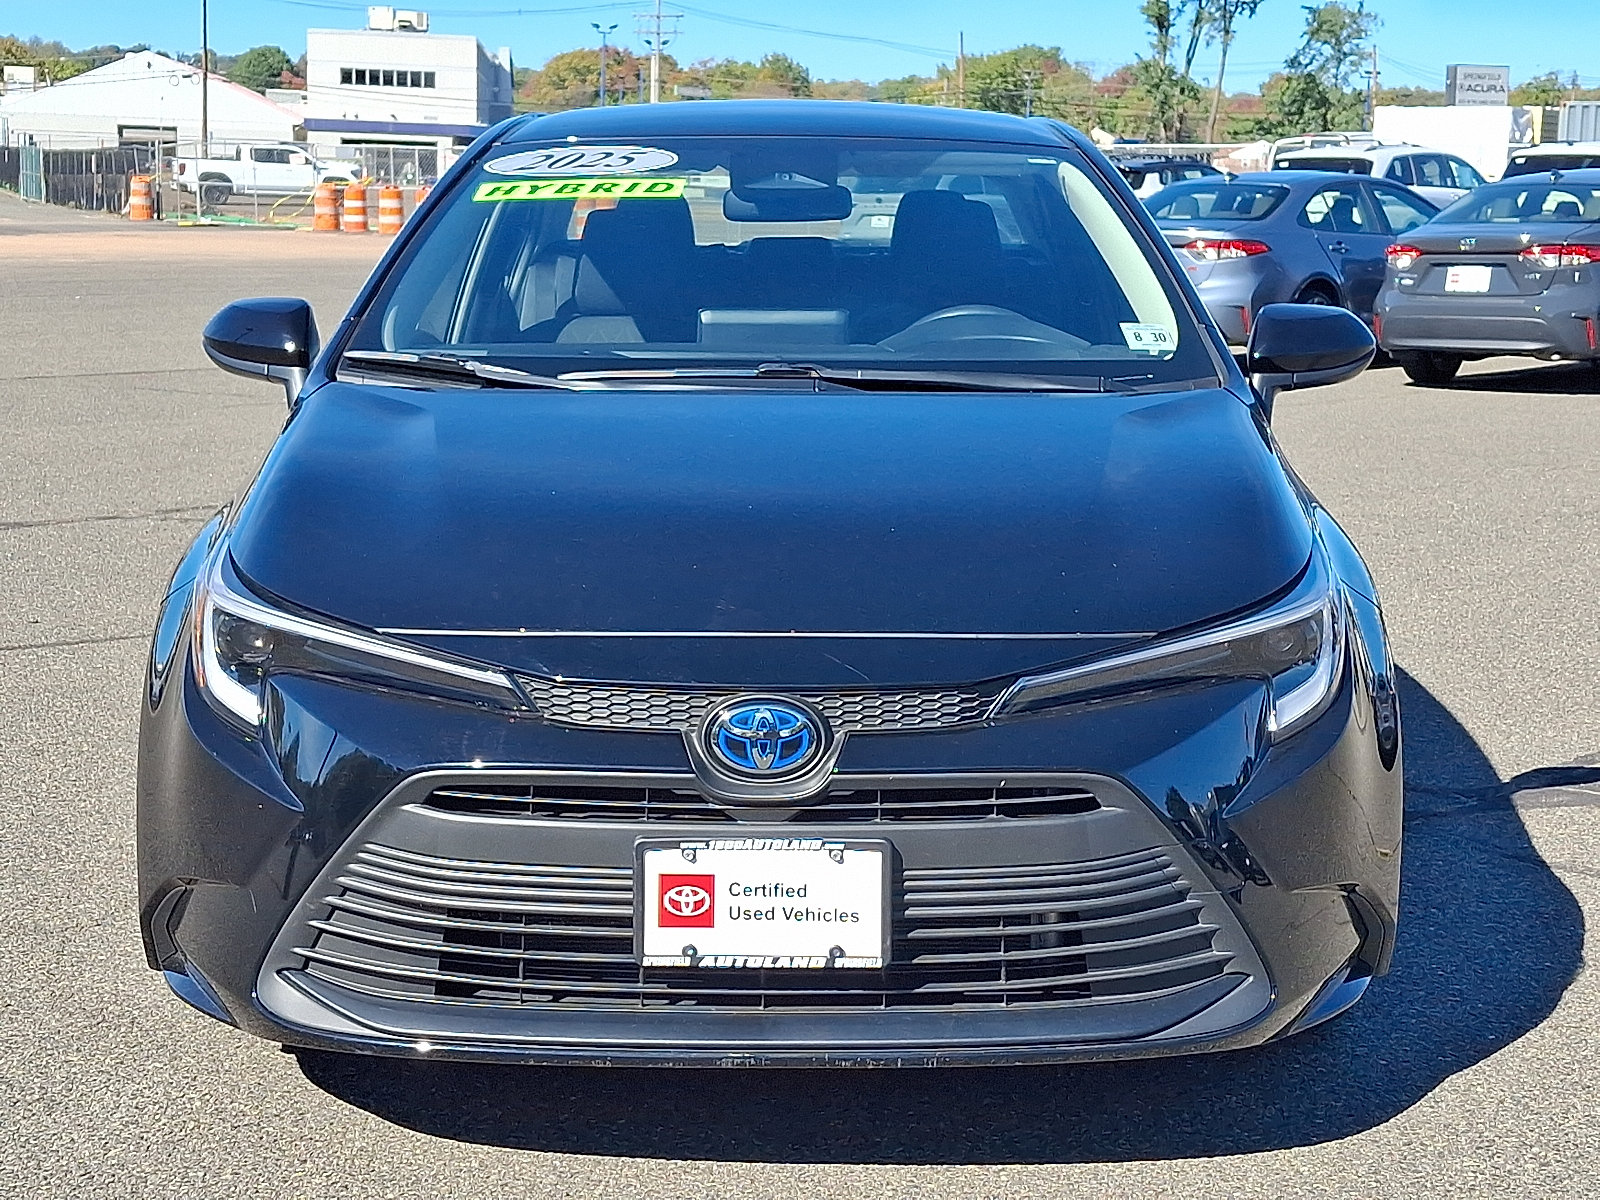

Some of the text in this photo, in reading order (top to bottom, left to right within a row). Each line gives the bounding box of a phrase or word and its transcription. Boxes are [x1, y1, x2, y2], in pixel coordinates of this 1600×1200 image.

[1465, 83, 1506, 93] ACURA
[513, 151, 647, 171] 2025
[484, 182, 675, 197] HYBRID
[1133, 331, 1167, 343] 8 30
[728, 882, 808, 898] Certified
[728, 905, 861, 923] Used Vehicles
[698, 956, 828, 969] AUTOLAND
